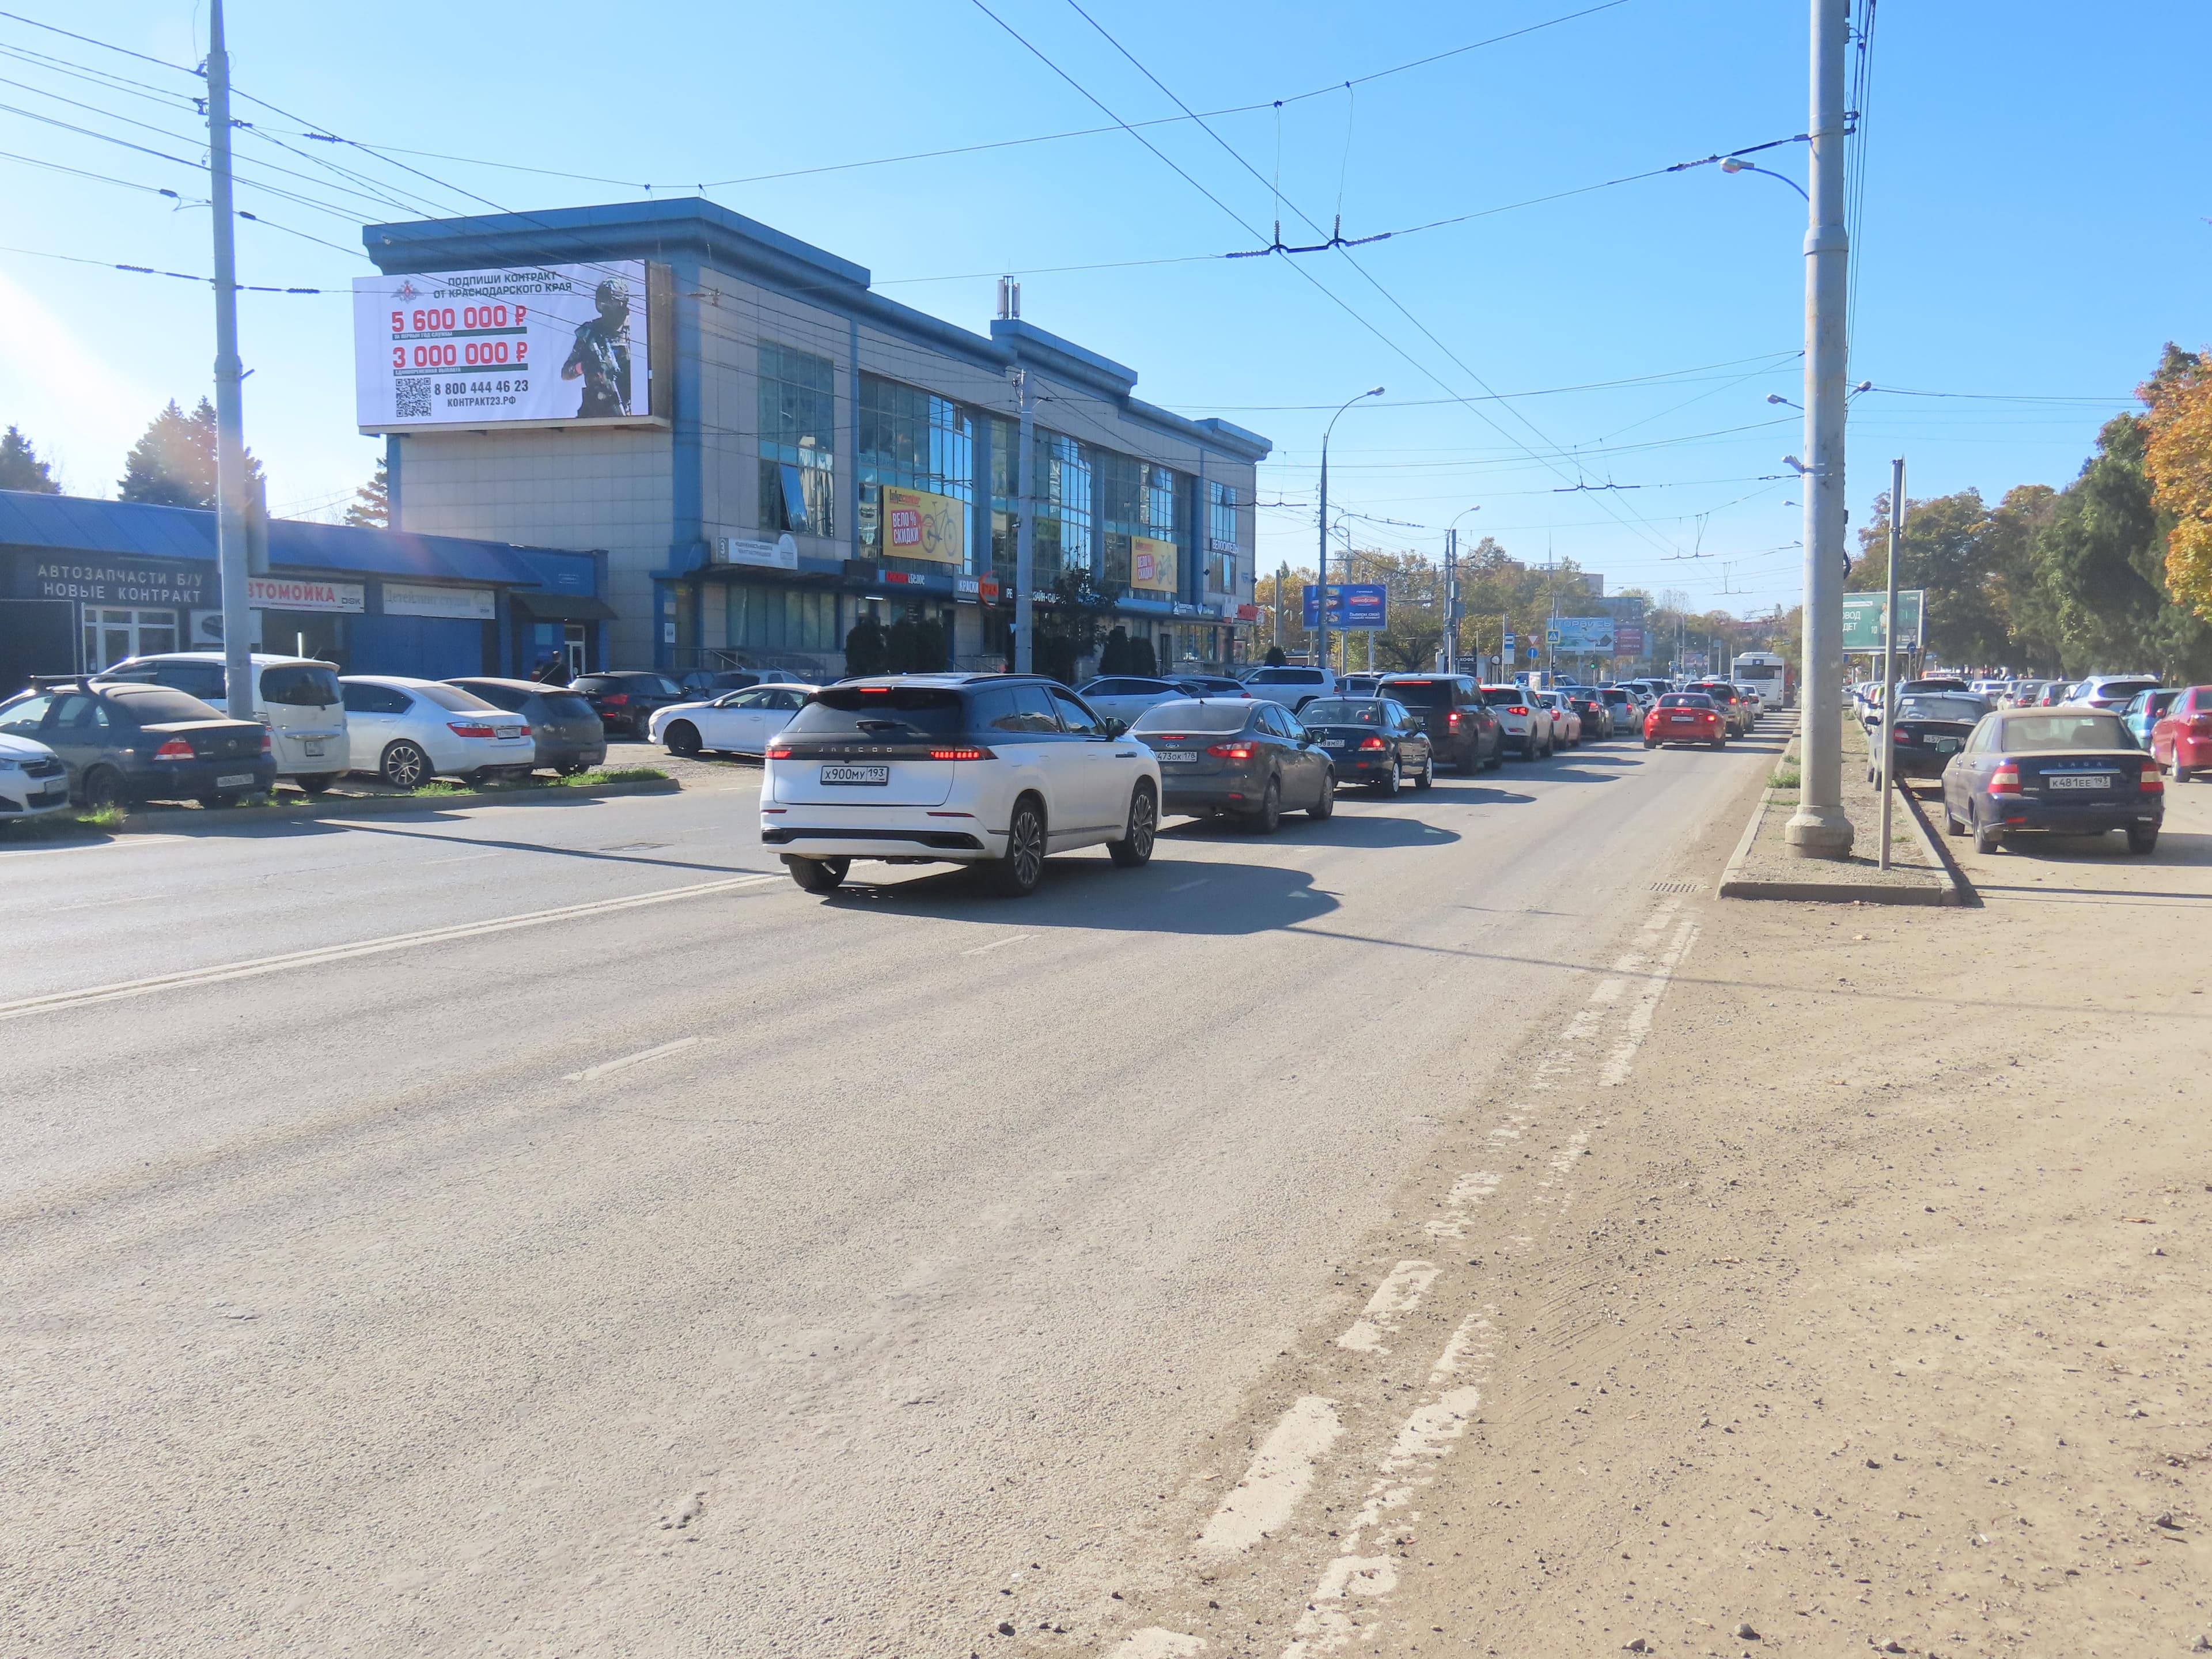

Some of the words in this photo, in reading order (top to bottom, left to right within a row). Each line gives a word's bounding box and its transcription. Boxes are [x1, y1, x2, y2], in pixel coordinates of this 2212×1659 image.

[448, 274, 501, 287] ПОДПИШИ
[505, 271, 556, 283] КОНТРАКТ
[433, 290, 445, 299] ОТ
[449, 283, 542, 298] КРАСНОДАРСКОГО
[546, 282, 572, 292] КРАЯ
[392, 311, 404, 332] 5
[413, 308, 456, 331] 600
[464, 305, 507, 328] 000
[393, 347, 406, 368] 3
[414, 344, 457, 367] 000
[465, 342, 508, 364] 000
[434, 384, 441, 396] 8
[445, 382, 467, 395] 800
[470, 381, 492, 393] 444
[496, 380, 510, 392] 46
[514, 379, 529, 392] 23
[447, 396, 517, 407] КОНТРАКТ23.РФ
[892, 512, 909, 527] ВЕЛО
[893, 527, 919, 544] СКИДКИ
[37, 565, 167, 585] АВТОЗАПЧАСТИ
[177, 573, 203, 586] Б/У
[44, 582, 105, 599] НОВЫЕ
[118, 587, 201, 603] КОНТРАКТ
[248, 580, 335, 602] ВТОМОЙКА
[1157, 752, 1181, 760] 473ОК
[824, 768, 866, 780] Х900МУ
[868, 768, 884, 777] 193
[2052, 778, 2091, 787] К481ЕЕ
